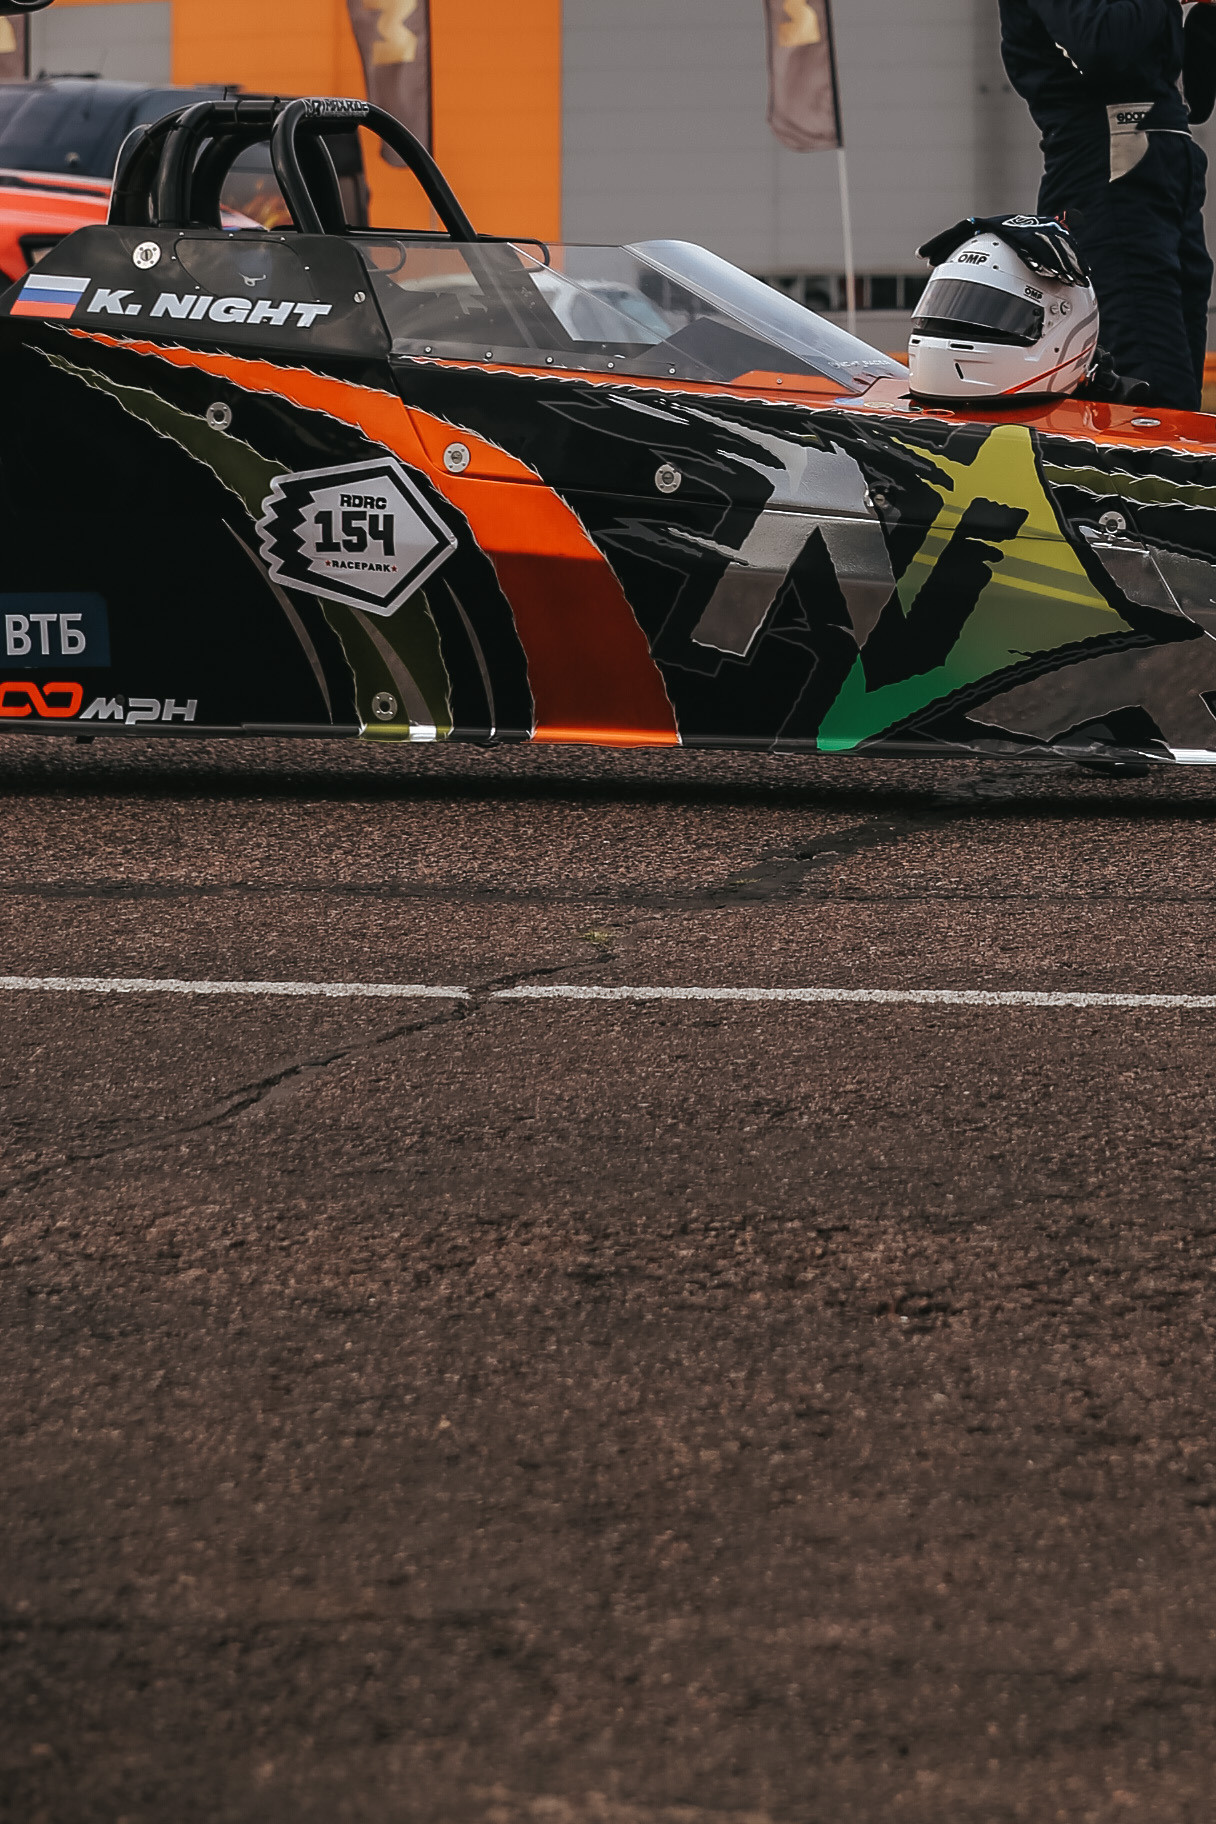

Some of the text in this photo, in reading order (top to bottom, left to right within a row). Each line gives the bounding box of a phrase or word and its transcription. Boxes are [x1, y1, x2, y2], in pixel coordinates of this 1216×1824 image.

[957, 252, 988, 265] OMP
[1024, 286, 1043, 300] OMP
[87, 288, 332, 327] K. NIGHT
[340, 493, 387, 510] RDRC
[314, 510, 395, 556] 154
[332, 560, 390, 573] RACEPARK
[5, 613, 86, 656] ВТБ
